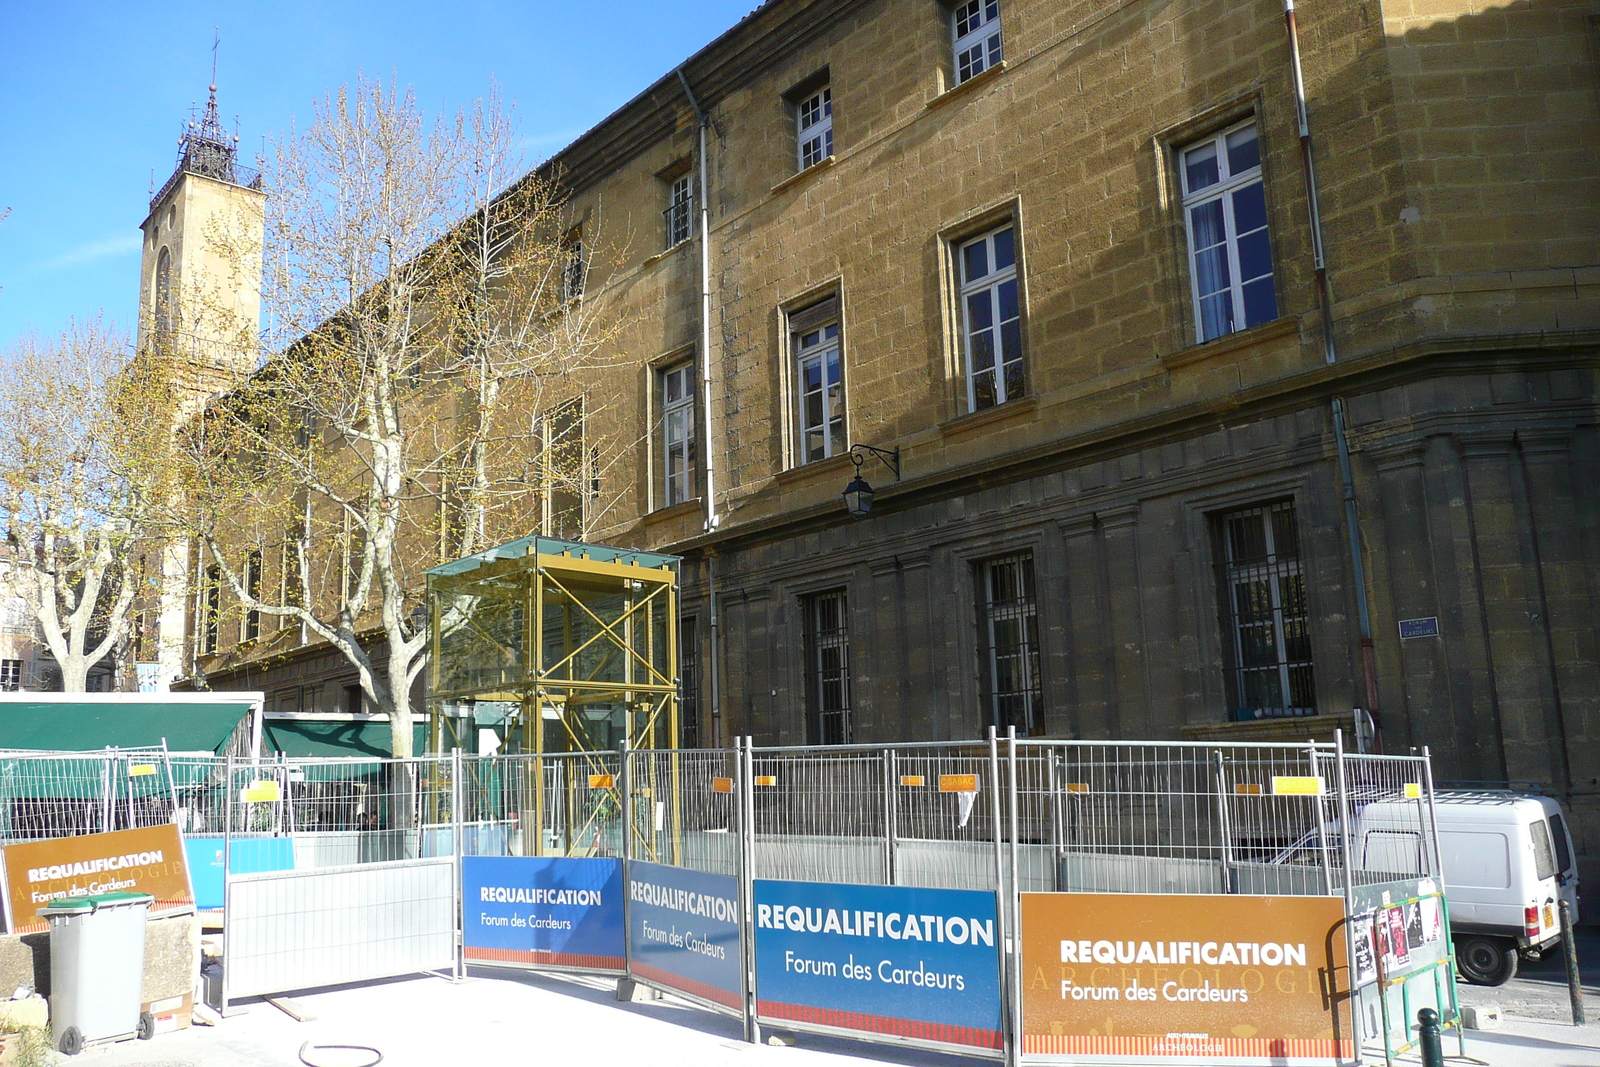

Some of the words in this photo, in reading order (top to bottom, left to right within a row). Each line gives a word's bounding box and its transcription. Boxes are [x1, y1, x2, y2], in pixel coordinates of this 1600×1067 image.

[28, 850, 163, 883] REQUALIFICATION
[31, 890, 66, 904] Forum
[69, 884, 87, 897] des
[89, 878, 136, 895] Cardeurs
[480, 887, 602, 906] REQUALIFICATION
[631, 880, 738, 924] REQUALIFICATION
[481, 912, 508, 927] Forum
[511, 912, 526, 928] des
[529, 914, 572, 930] Cardeurs
[757, 904, 994, 947] REQUALIFICATION
[643, 920, 668, 943] Forum
[669, 925, 684, 948] des
[685, 931, 725, 960] Cardeurs
[1060, 940, 1306, 966] REQUALIFICATION
[785, 950, 837, 977] Forum
[842, 954, 873, 981] des
[878, 960, 965, 991] Cardeurs
[1061, 980, 1119, 1000] Forum
[1125, 978, 1157, 1001] des
[1162, 980, 1248, 1002] Cardeurs
